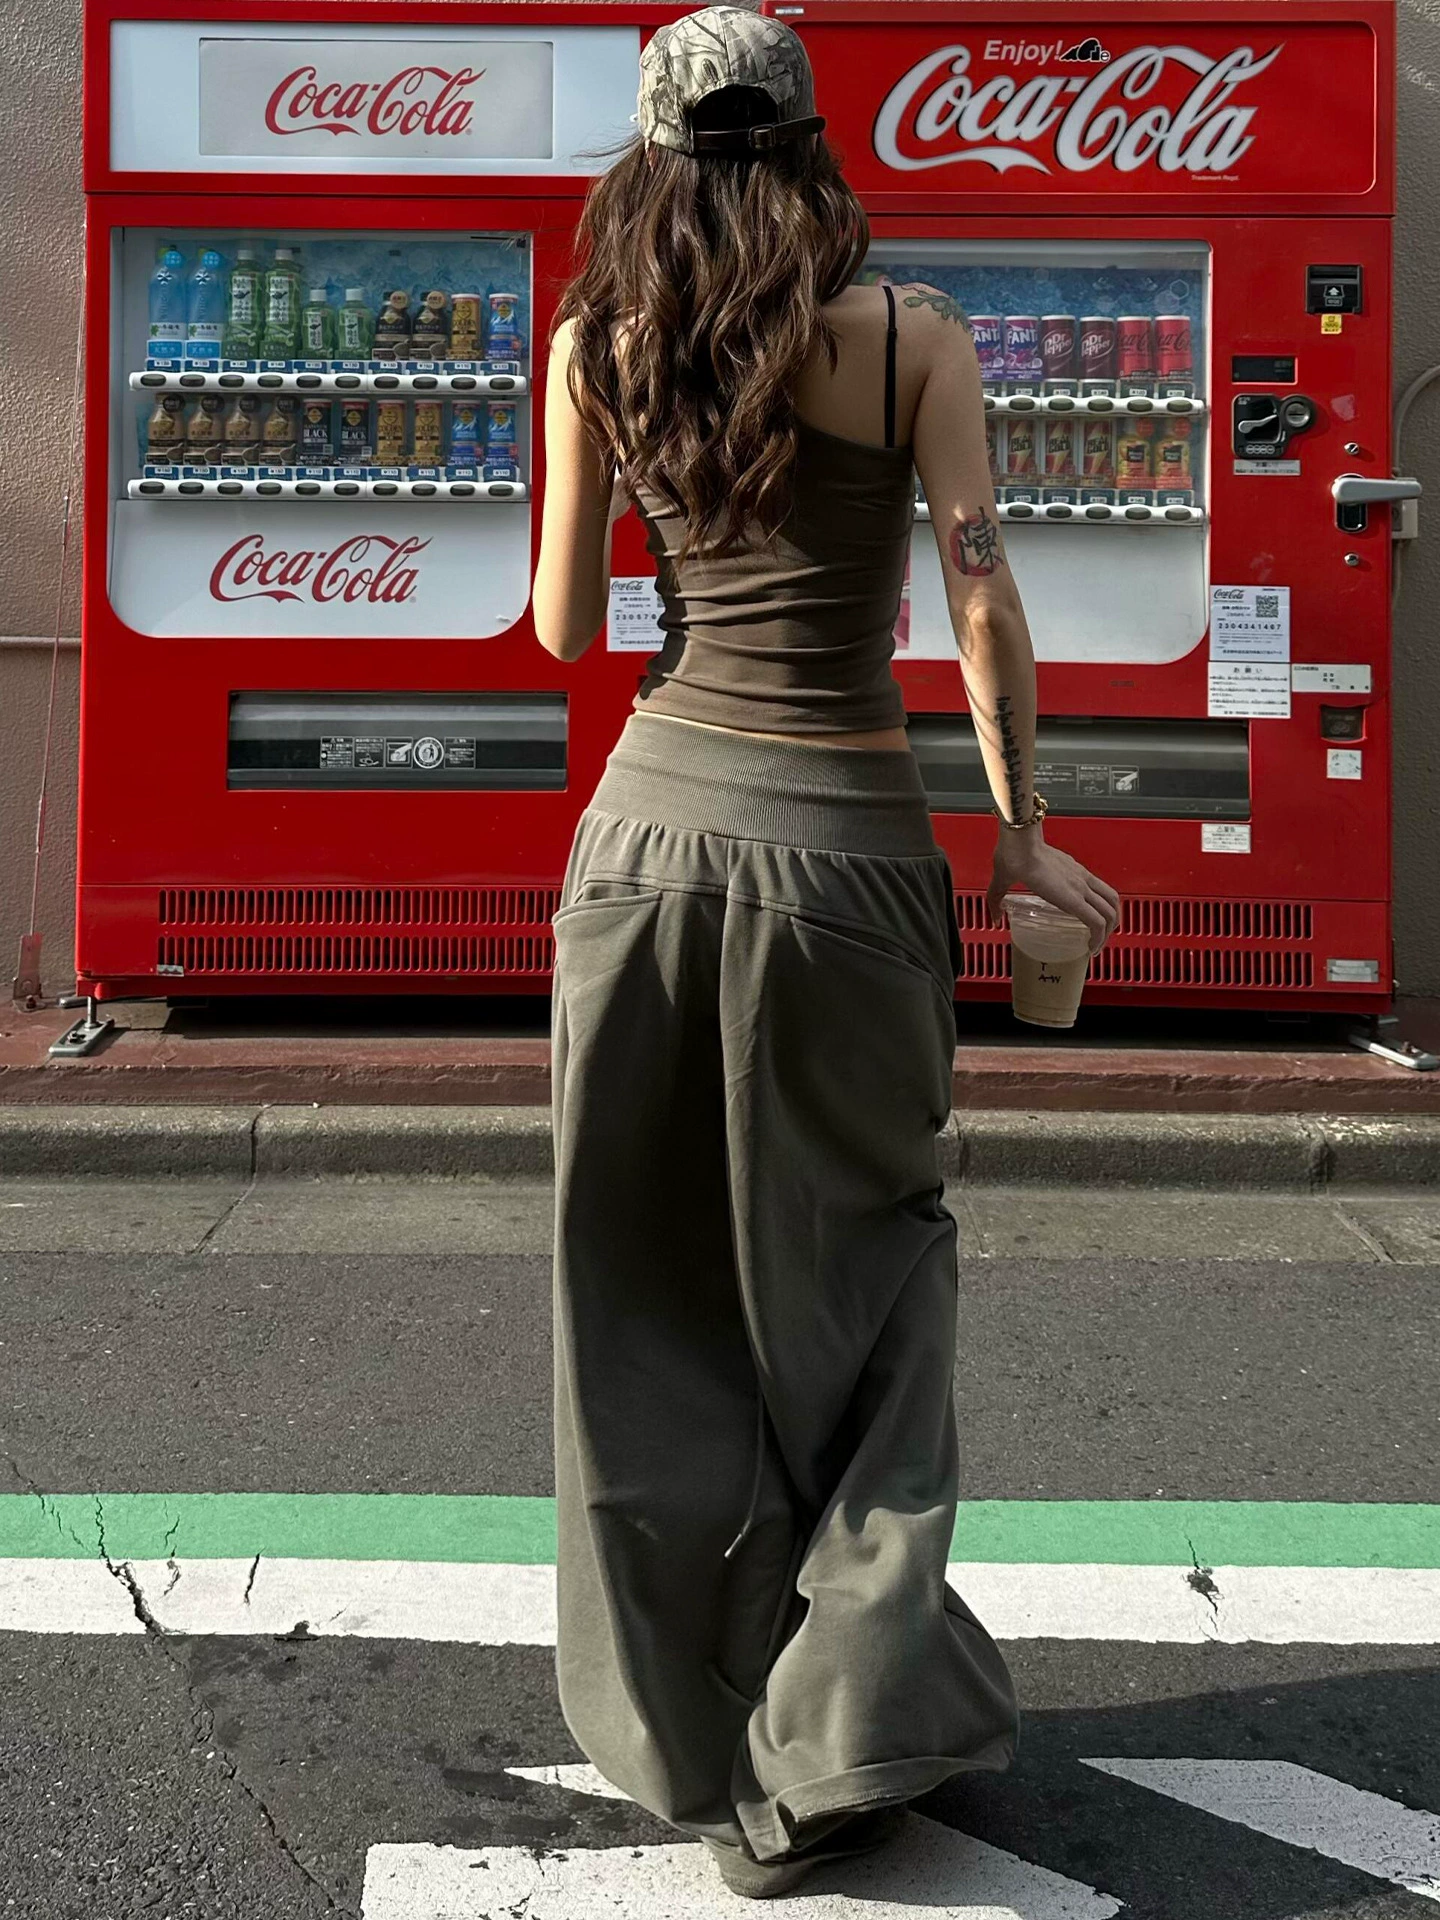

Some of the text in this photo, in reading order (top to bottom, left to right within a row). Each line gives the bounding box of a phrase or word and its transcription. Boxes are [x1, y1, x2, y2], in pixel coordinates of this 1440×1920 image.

[984, 40, 1063, 65] Enjoy!
[264, 66, 487, 136] Coca-Cola
[873, 42, 1286, 175] Coca-Cola
[971, 328, 1000, 343] ANT
[1052, 334, 1066, 344] Dr
[1088, 335, 1103, 346] Dr
[1045, 338, 1072, 355] Pepper
[1082, 340, 1110, 357] Pepper
[304, 429, 327, 437] BLACK
[342, 431, 366, 439] BLACK
[210, 534, 434, 604] Coca-Cola
[611, 581, 644, 591] Coca-Cola
[1214, 589, 1244, 599] Coca-Cola
